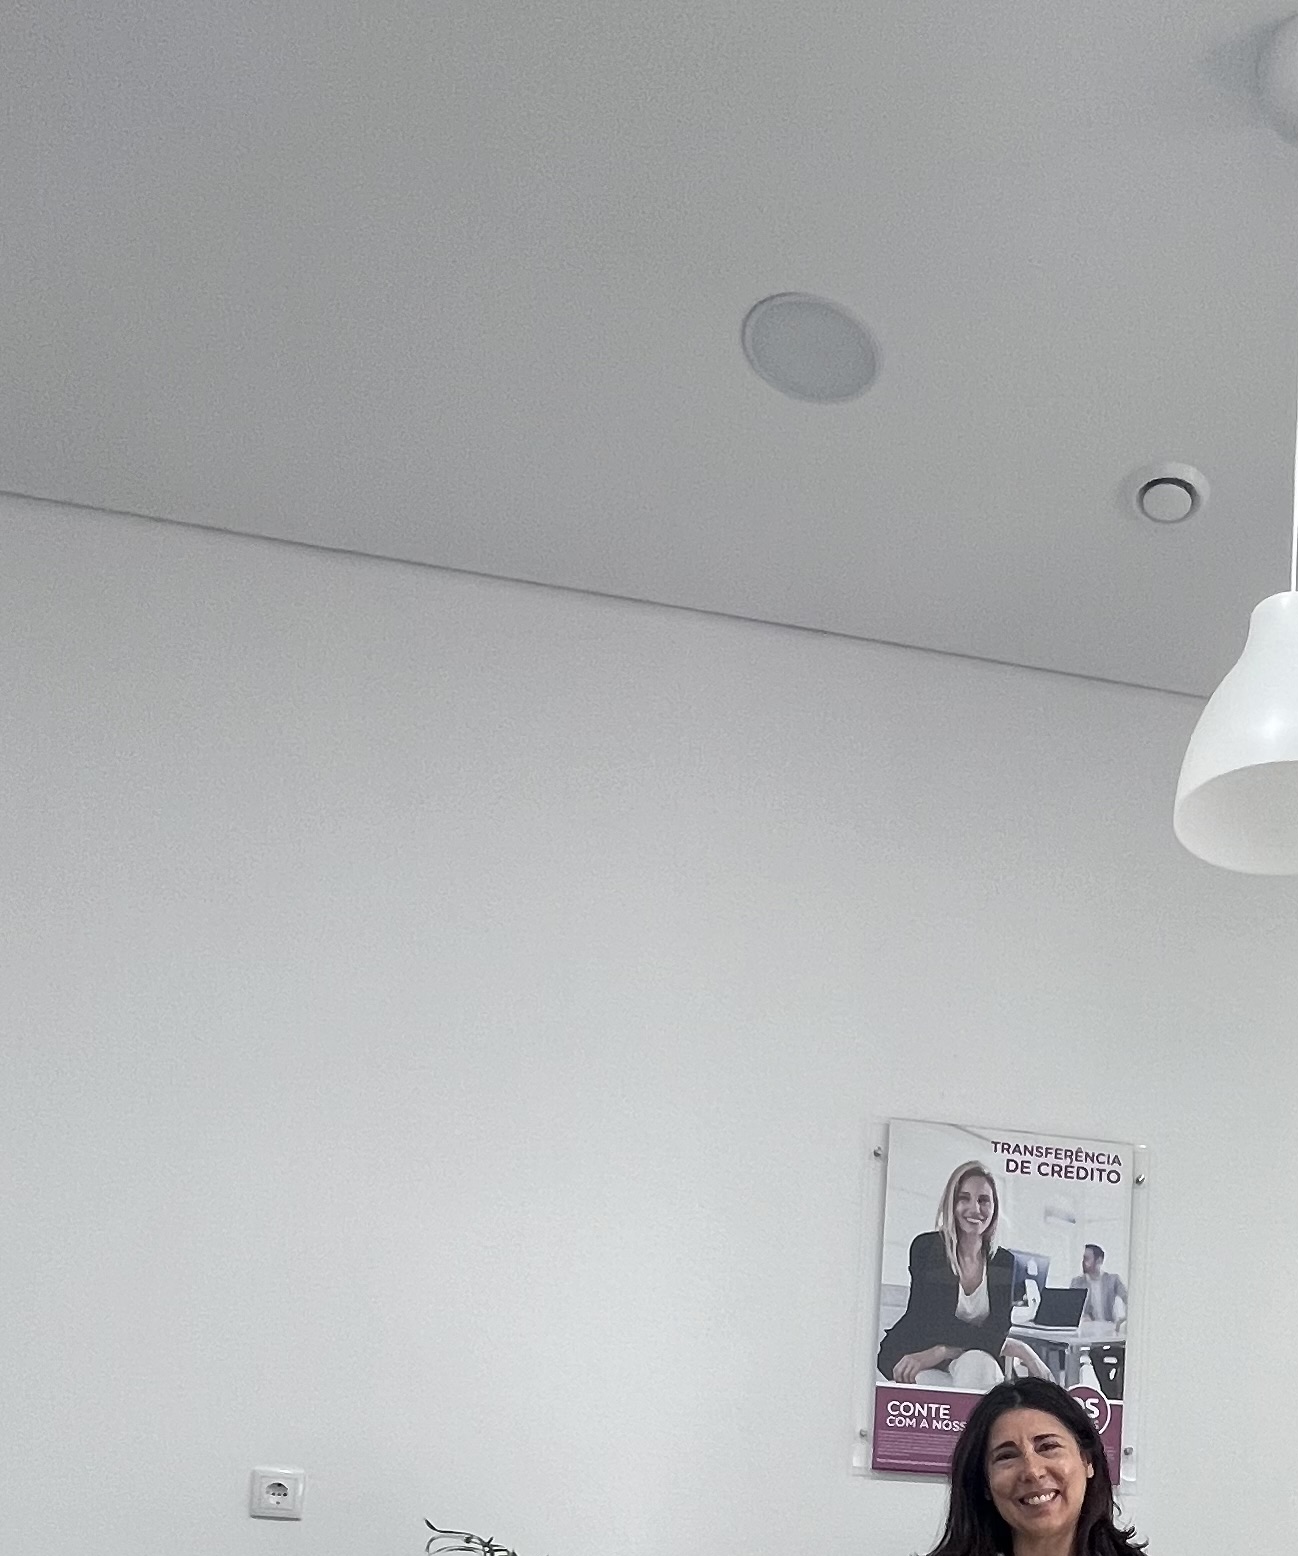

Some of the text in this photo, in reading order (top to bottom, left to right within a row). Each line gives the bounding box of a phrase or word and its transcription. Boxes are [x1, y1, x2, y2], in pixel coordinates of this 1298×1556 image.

[991, 1140, 1122, 1166] TRANSFERÊNCIA
[1005, 1157, 1122, 1184] DE CRÉDITO
[887, 1400, 951, 1419] CONTE
[886, 1416, 967, 1432] COM A NOSS
